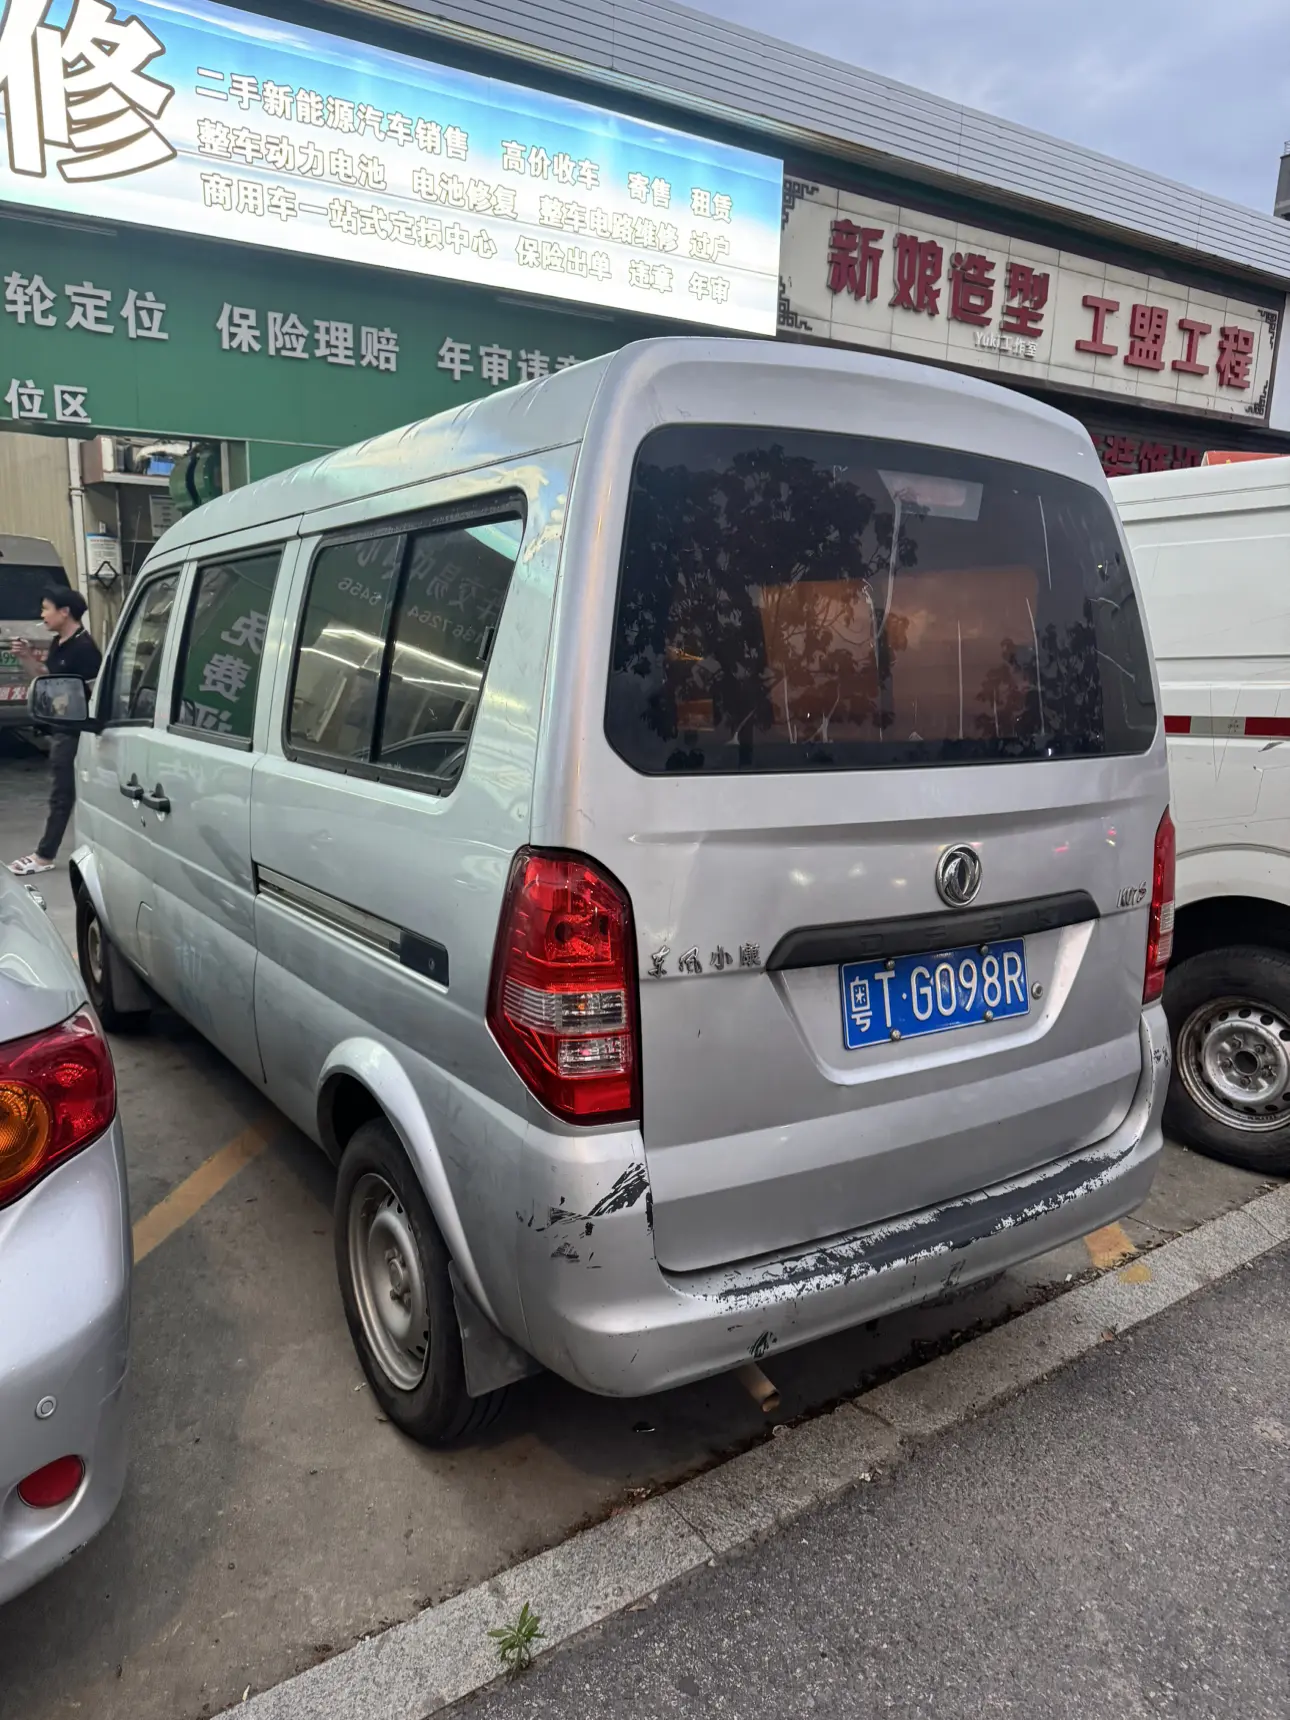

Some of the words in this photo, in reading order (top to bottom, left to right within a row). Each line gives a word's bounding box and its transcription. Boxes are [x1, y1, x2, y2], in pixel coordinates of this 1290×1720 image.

[195, 66, 470, 162] 二手新能源汽车销售
[501, 139, 601, 190] 高价收车
[627, 171, 672, 210] 寄售
[690, 187, 734, 224] 租赁
[196, 118, 388, 192] 整车动力电池
[412, 167, 519, 221] 电池修复
[538, 194, 679, 254] 整车电路维修
[688, 230, 731, 263] 过户
[199, 172, 498, 260] 商用车一站式定损中心
[515, 235, 613, 281] 保险出单
[628, 259, 674, 294] 违章
[688, 271, 731, 304] 年审
[827, 218, 1050, 338] 新娘造型
[1075, 294, 1256, 390] 工盟工程
[3, 270, 170, 342] 轮定位
[216, 301, 401, 373] 保险理赔
[5, 377, 92, 425] 位区
[648, 943, 762, 979] 东风小康
